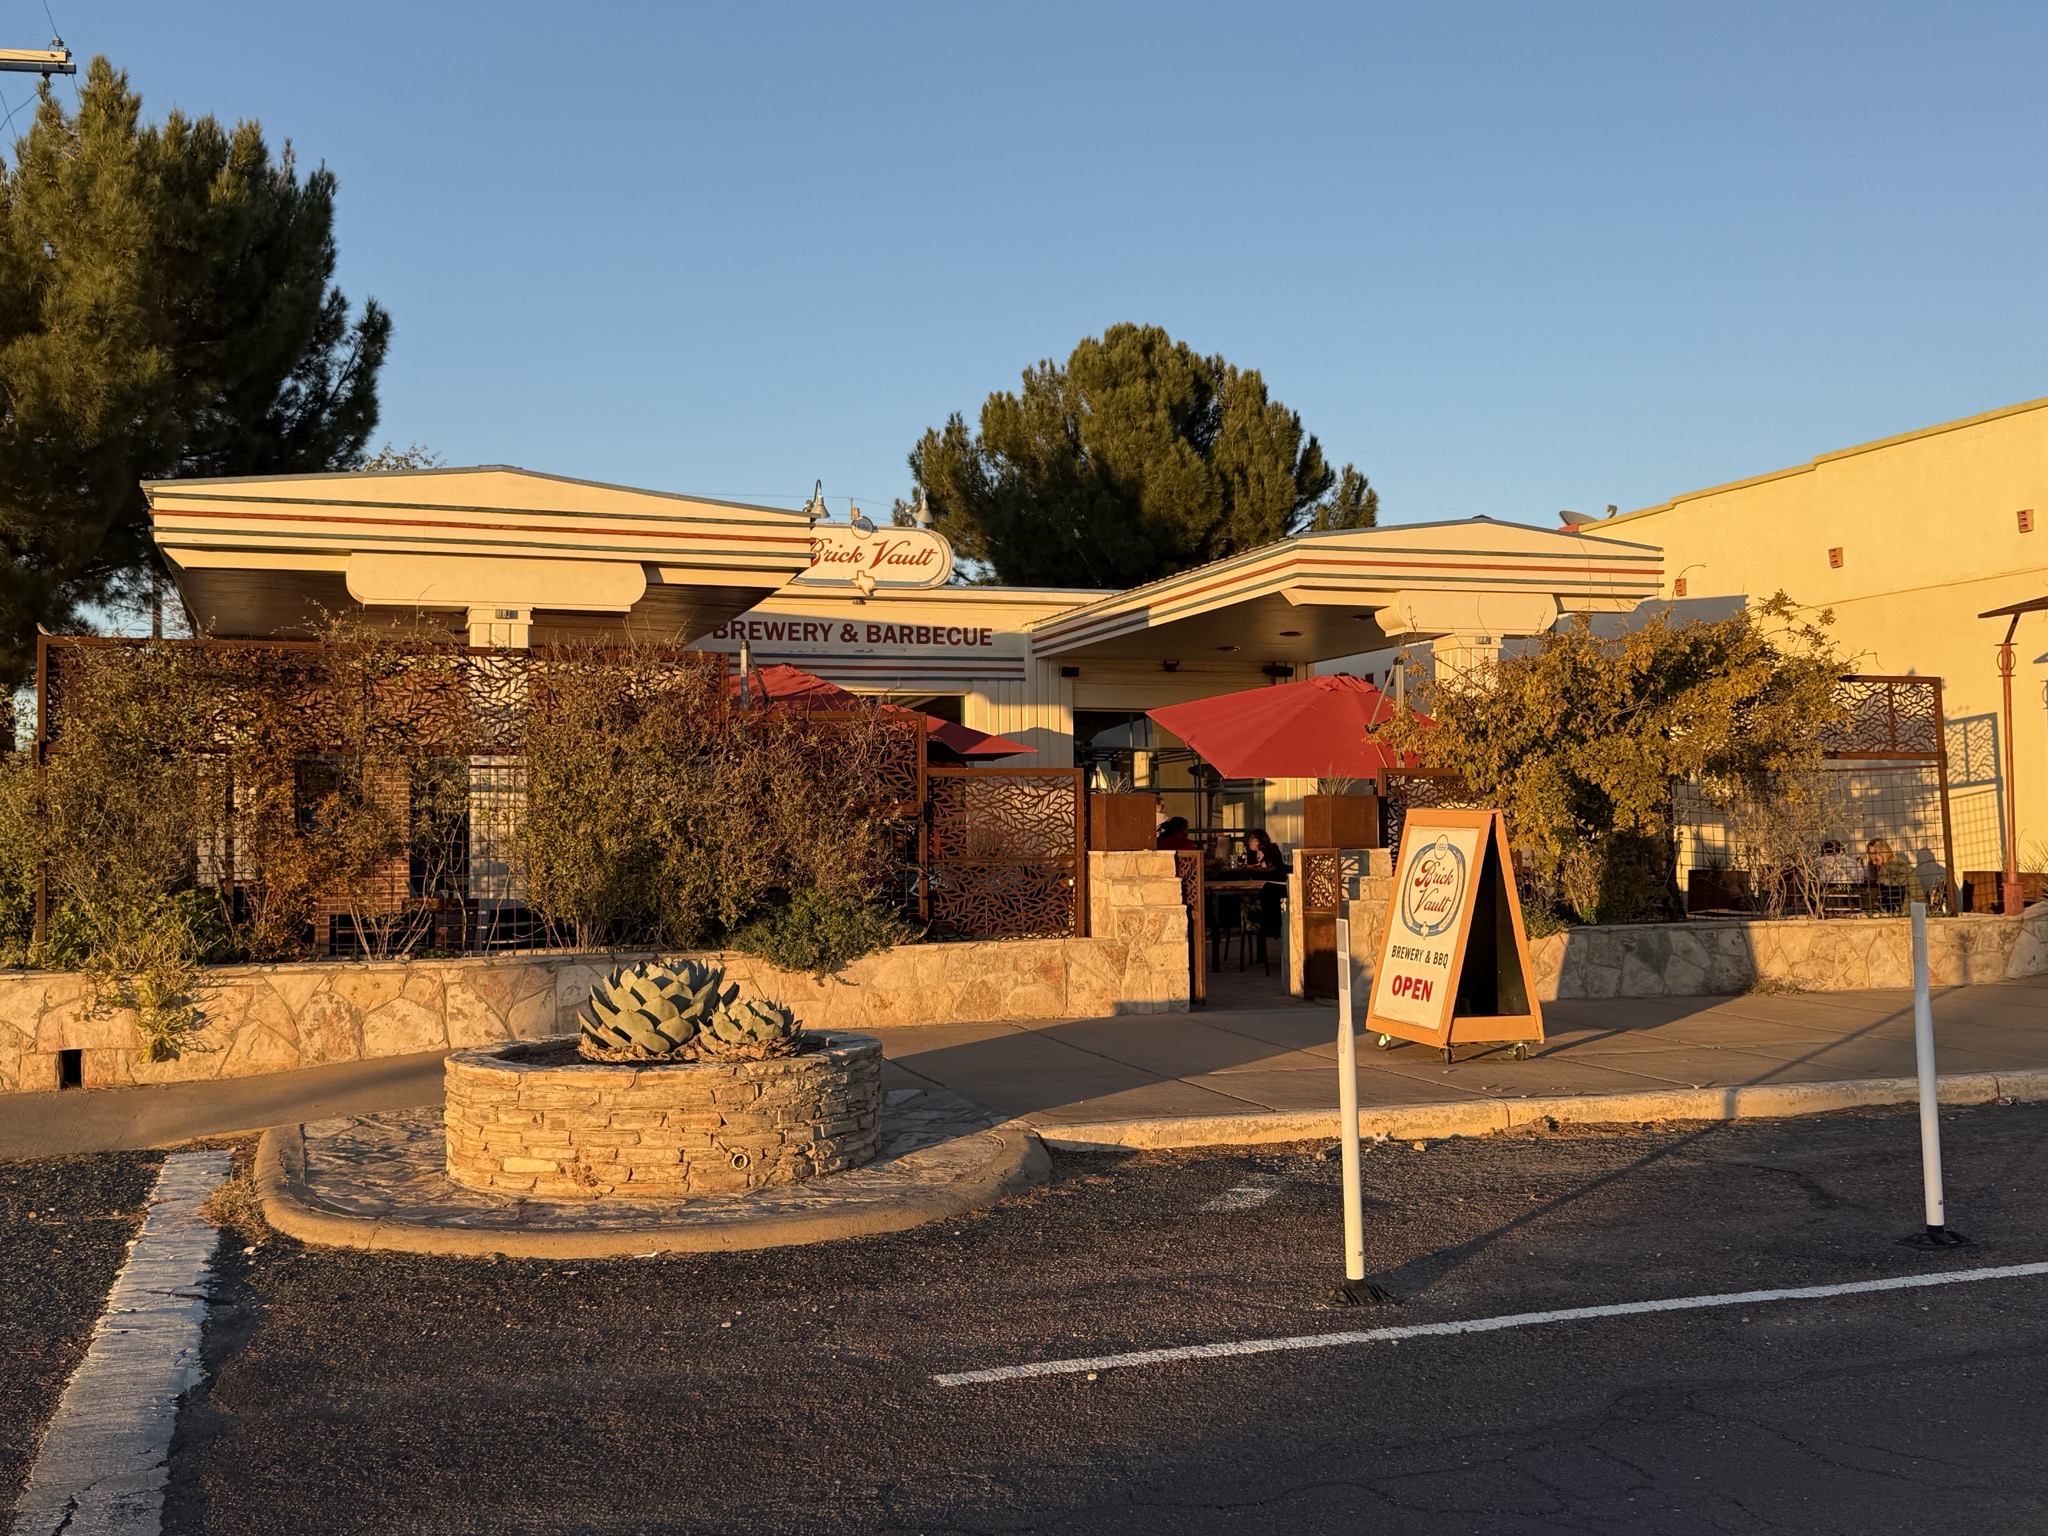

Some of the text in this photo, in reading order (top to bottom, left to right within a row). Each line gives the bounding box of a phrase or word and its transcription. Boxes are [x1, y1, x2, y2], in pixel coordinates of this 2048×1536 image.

[869, 539, 938, 569] Vault
[713, 620, 993, 646] BREWERY & BARBECUE
[1415, 860, 1454, 887] Brick
[1413, 887, 1451, 914] Vault
[1391, 945, 1449, 968] BREWERY & BBQ
[1391, 974, 1433, 1002] OPEN
